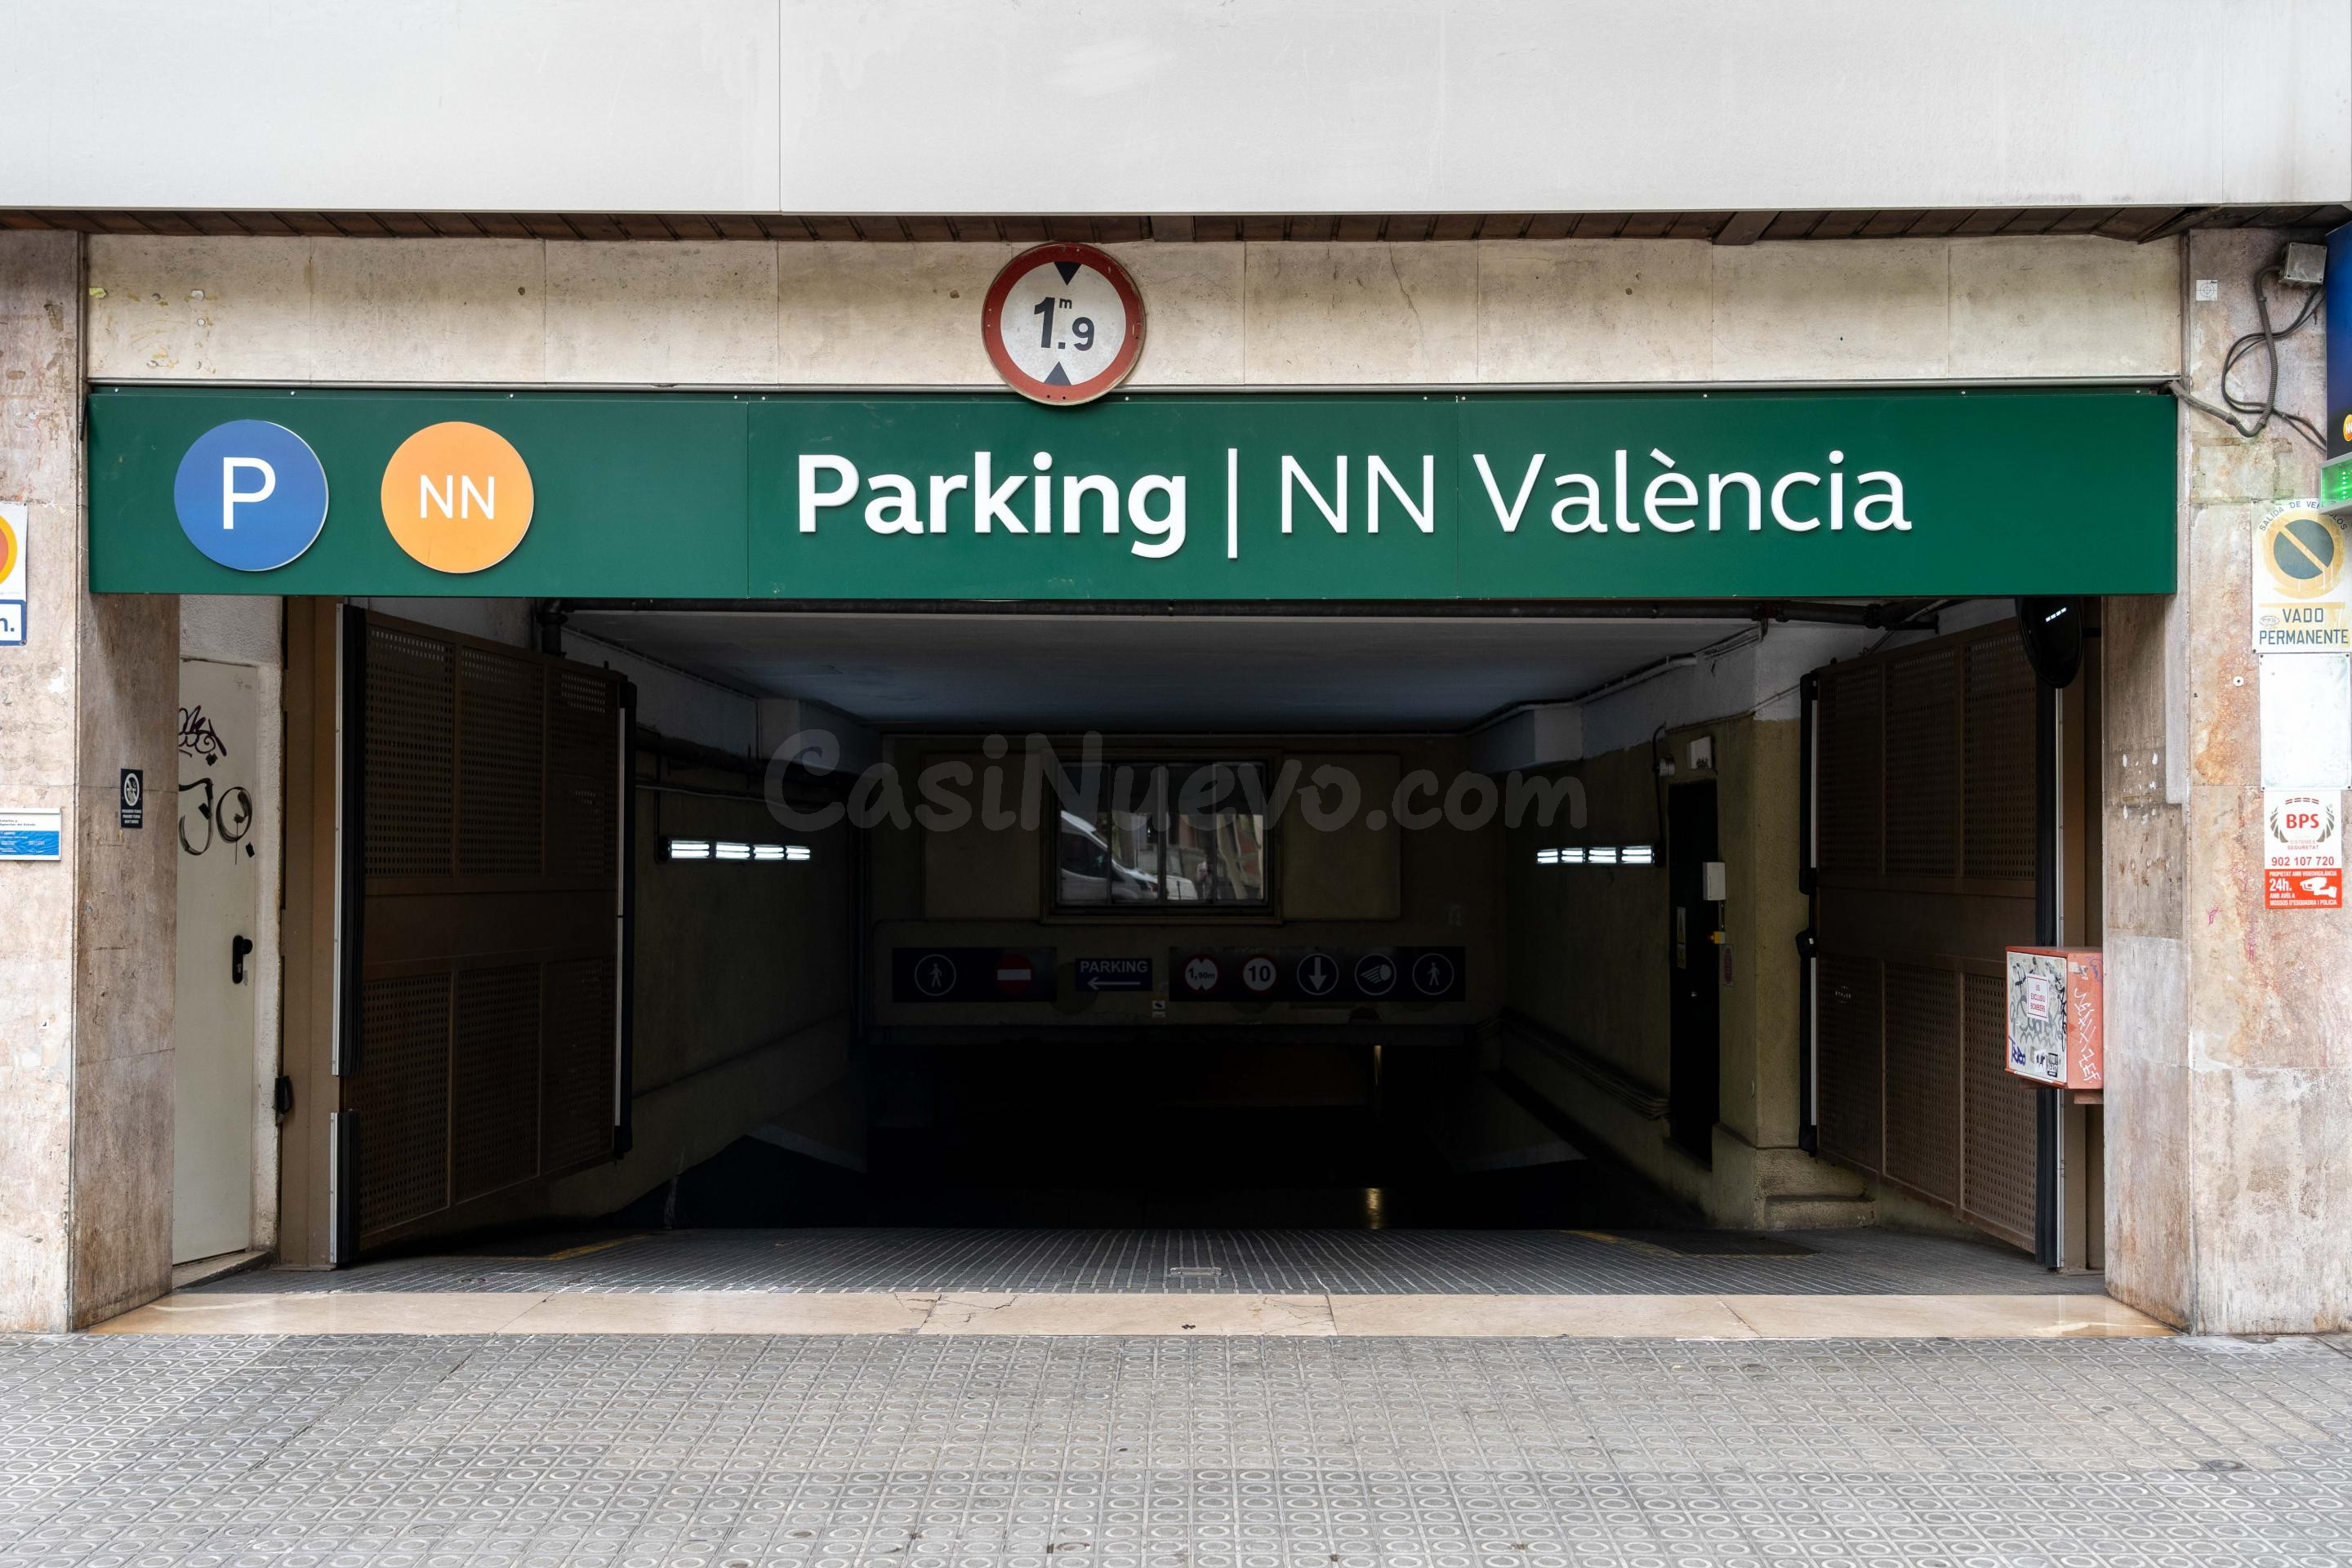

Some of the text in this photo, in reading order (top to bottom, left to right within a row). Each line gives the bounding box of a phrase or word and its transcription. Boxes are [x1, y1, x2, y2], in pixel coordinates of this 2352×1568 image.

[223, 457, 276, 530] P
[420, 474, 495, 519] NN
[797, 451, 1188, 559] Parking
[1281, 455, 1435, 535] NN
[1473, 448, 1913, 535] València
[2259, 506, 2284, 532] SALIDA
[2289, 501, 2301, 509] DE
[2283, 608, 2324, 623] VADO
[2259, 629, 2349, 645] PERMANENTE
[2286, 813, 2319, 829] BPS
[2271, 856, 2334, 866] 902 107 720
[2269, 878, 2292, 892] 24h.
[1080, 960, 1150, 973] PARKING
[1248, 965, 1271, 982] 10
